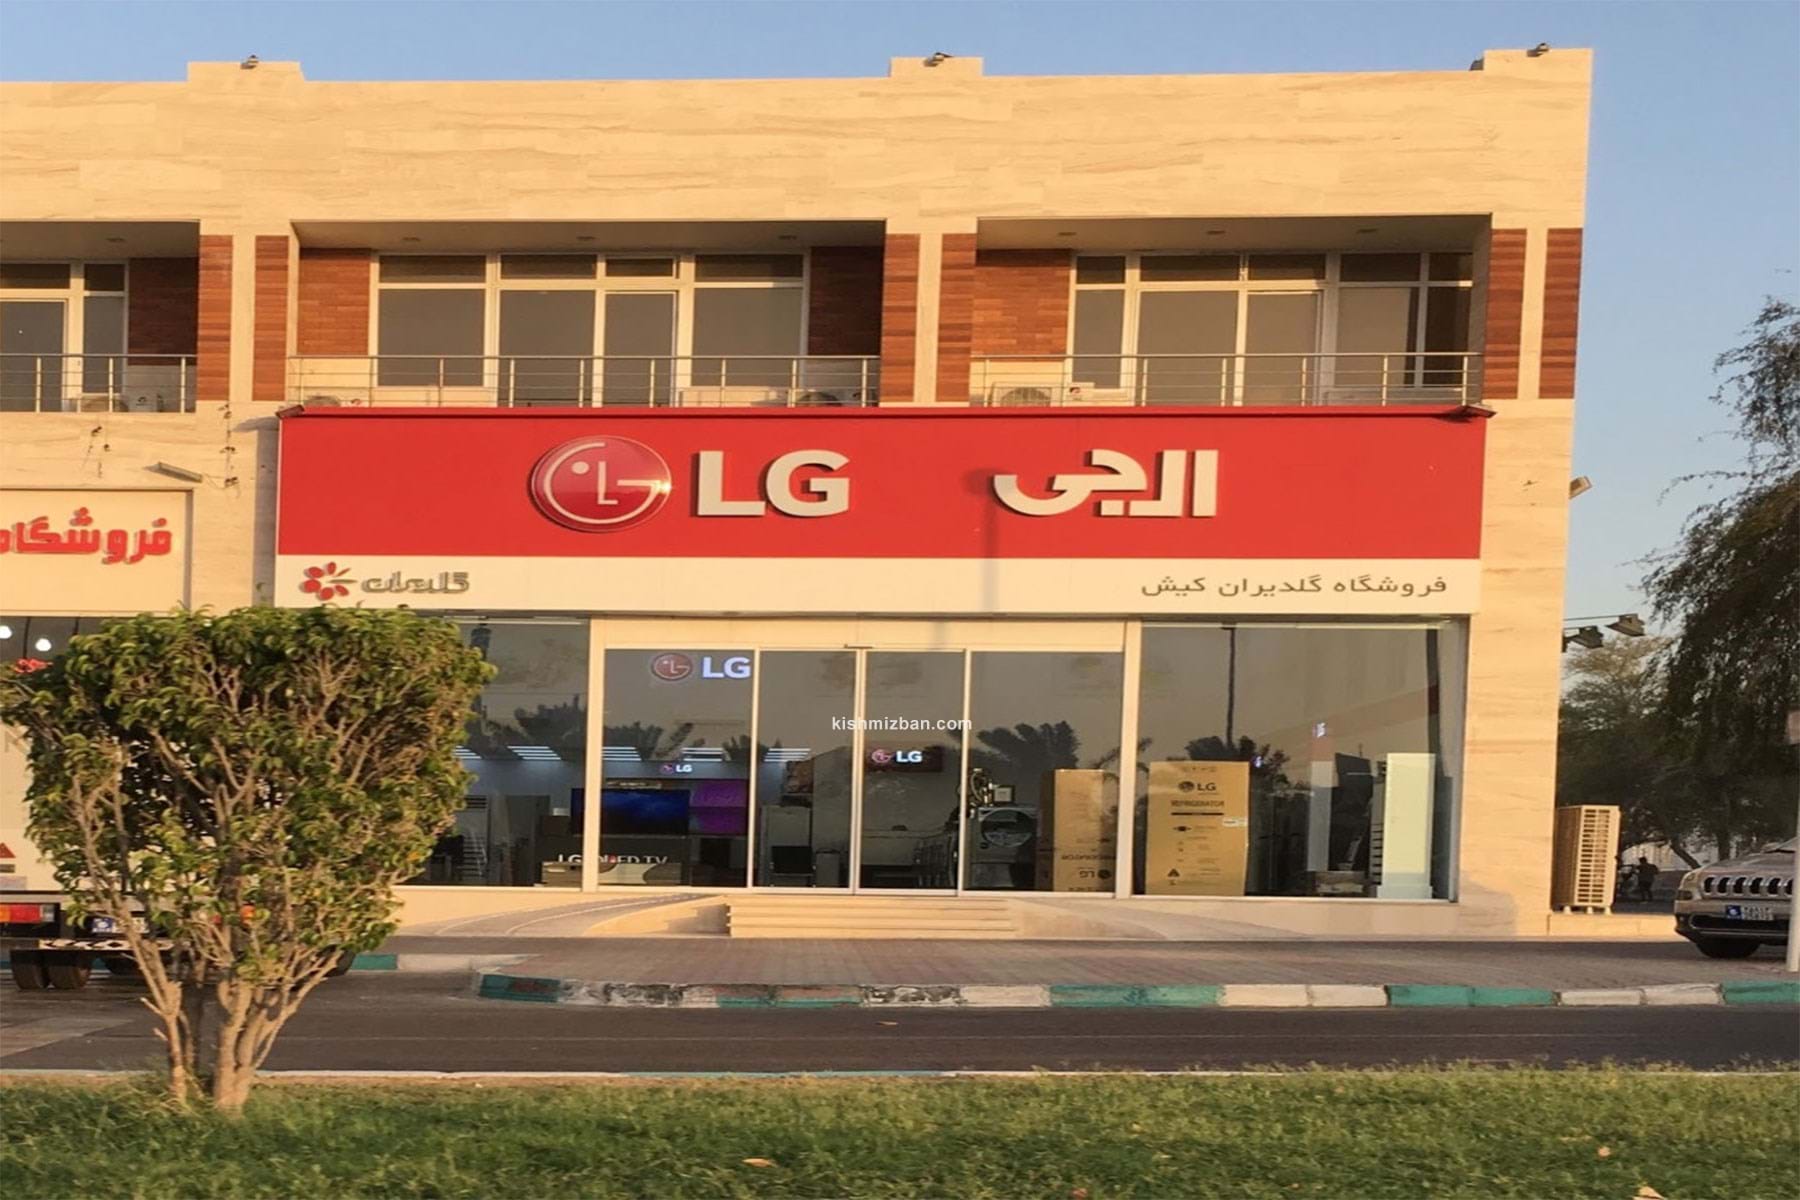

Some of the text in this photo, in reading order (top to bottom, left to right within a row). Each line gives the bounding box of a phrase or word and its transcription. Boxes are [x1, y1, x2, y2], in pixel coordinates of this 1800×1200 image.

[697, 449, 850, 517] LG
[1141, 573, 1447, 598] فروشگاه گلدیران کیش
[702, 656, 751, 679] LG
[895, 750, 923, 763] LG
[676, 764, 692, 773] LG
[1197, 782, 1217, 791] LG
